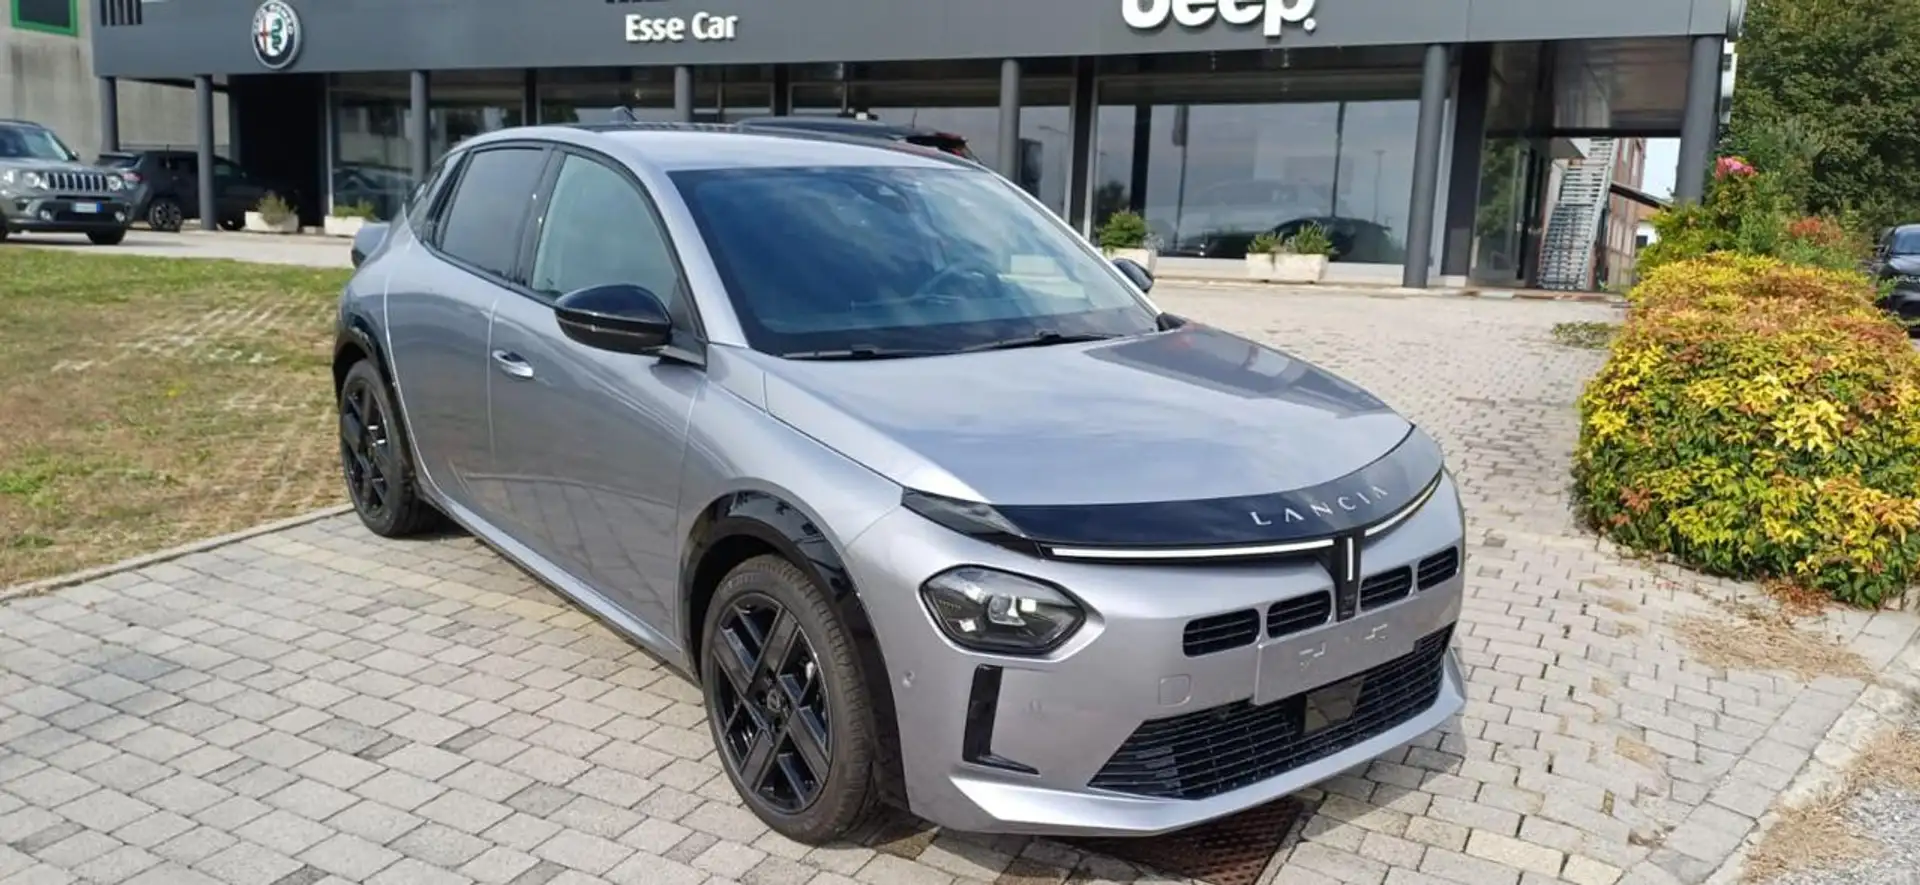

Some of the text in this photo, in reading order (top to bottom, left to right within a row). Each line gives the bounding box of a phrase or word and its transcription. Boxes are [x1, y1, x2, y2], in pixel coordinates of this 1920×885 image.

[625, 11, 738, 42] Esse Car
[1250, 485, 1388, 526] LANCIA
